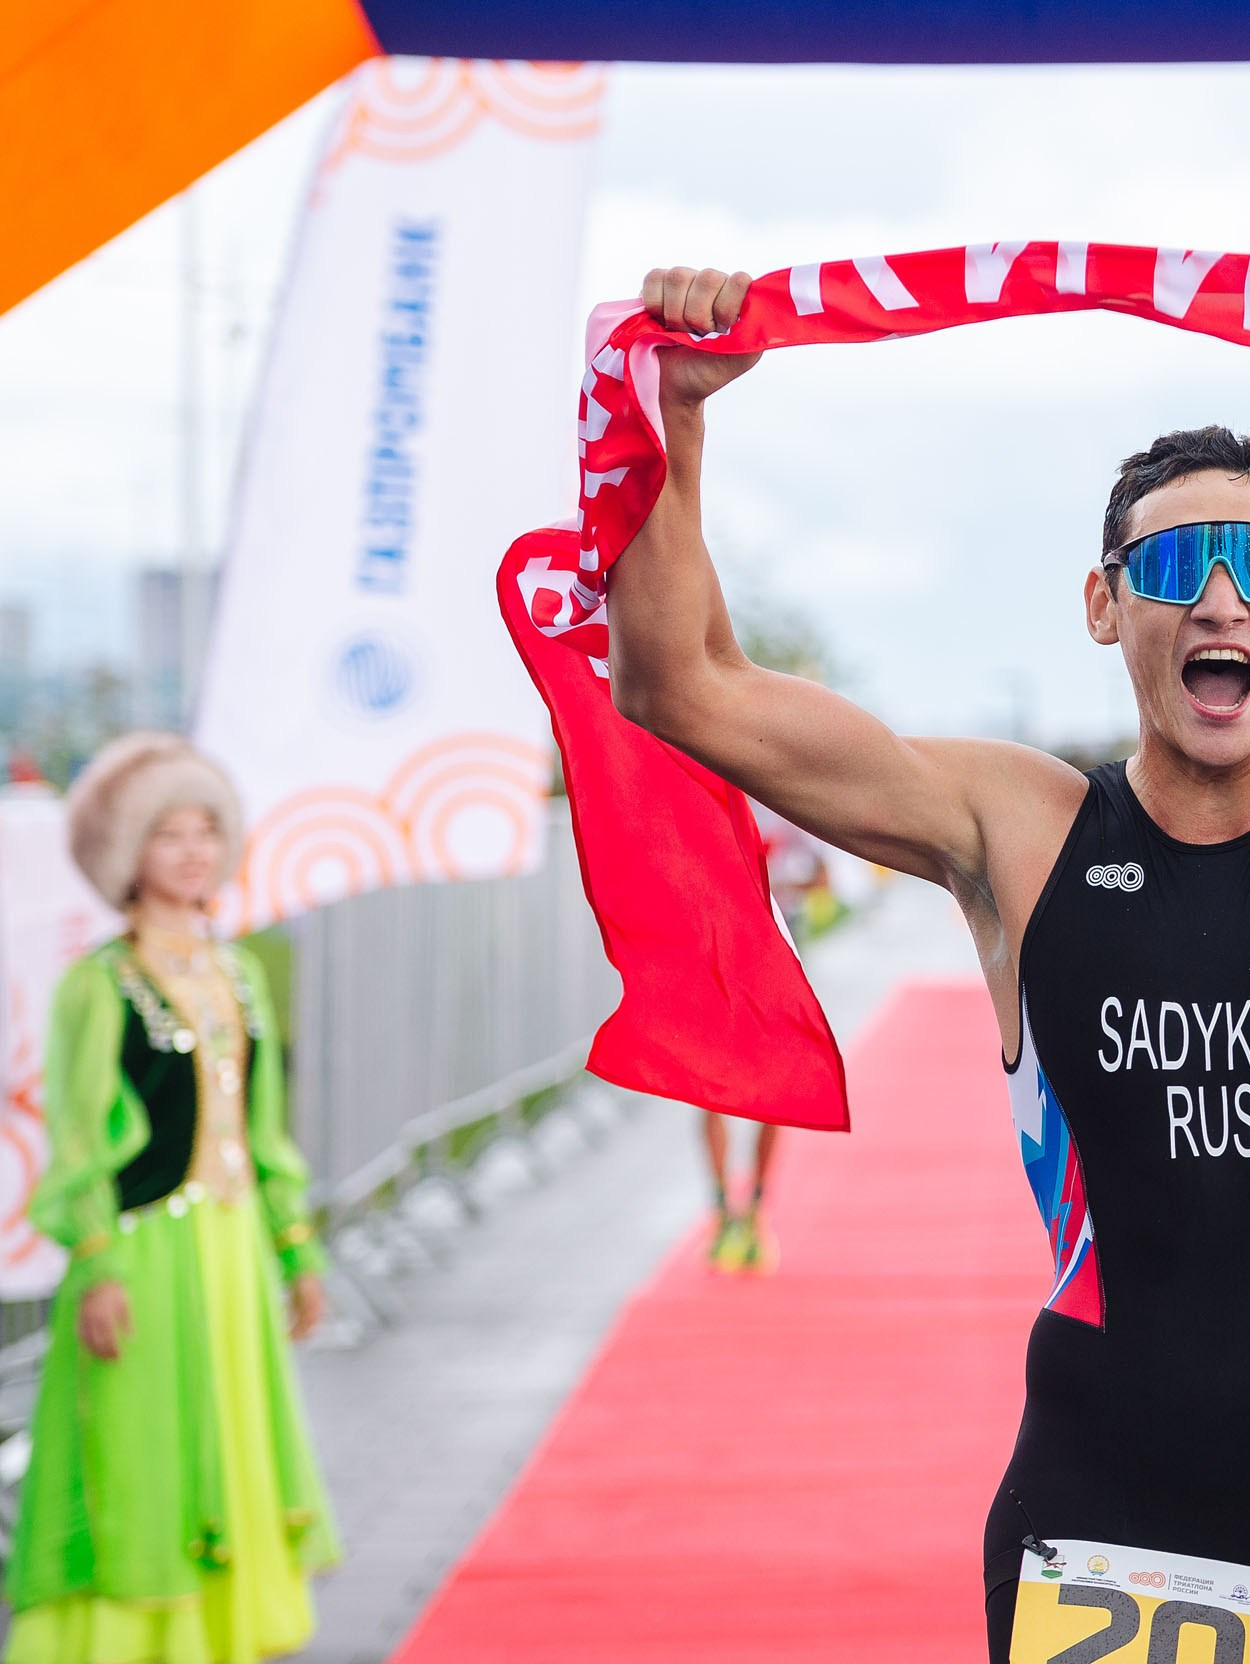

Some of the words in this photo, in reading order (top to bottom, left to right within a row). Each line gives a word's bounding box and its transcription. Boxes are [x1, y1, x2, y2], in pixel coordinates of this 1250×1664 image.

[1174, 1574, 1214, 1585] ФЕДЕРАЦИЯ
[1172, 1586, 1199, 1595] РОССИИ
[1173, 1580, 1213, 1592] ТРИАТЛОНА
[1046, 1583, 1246, 1664] 20
